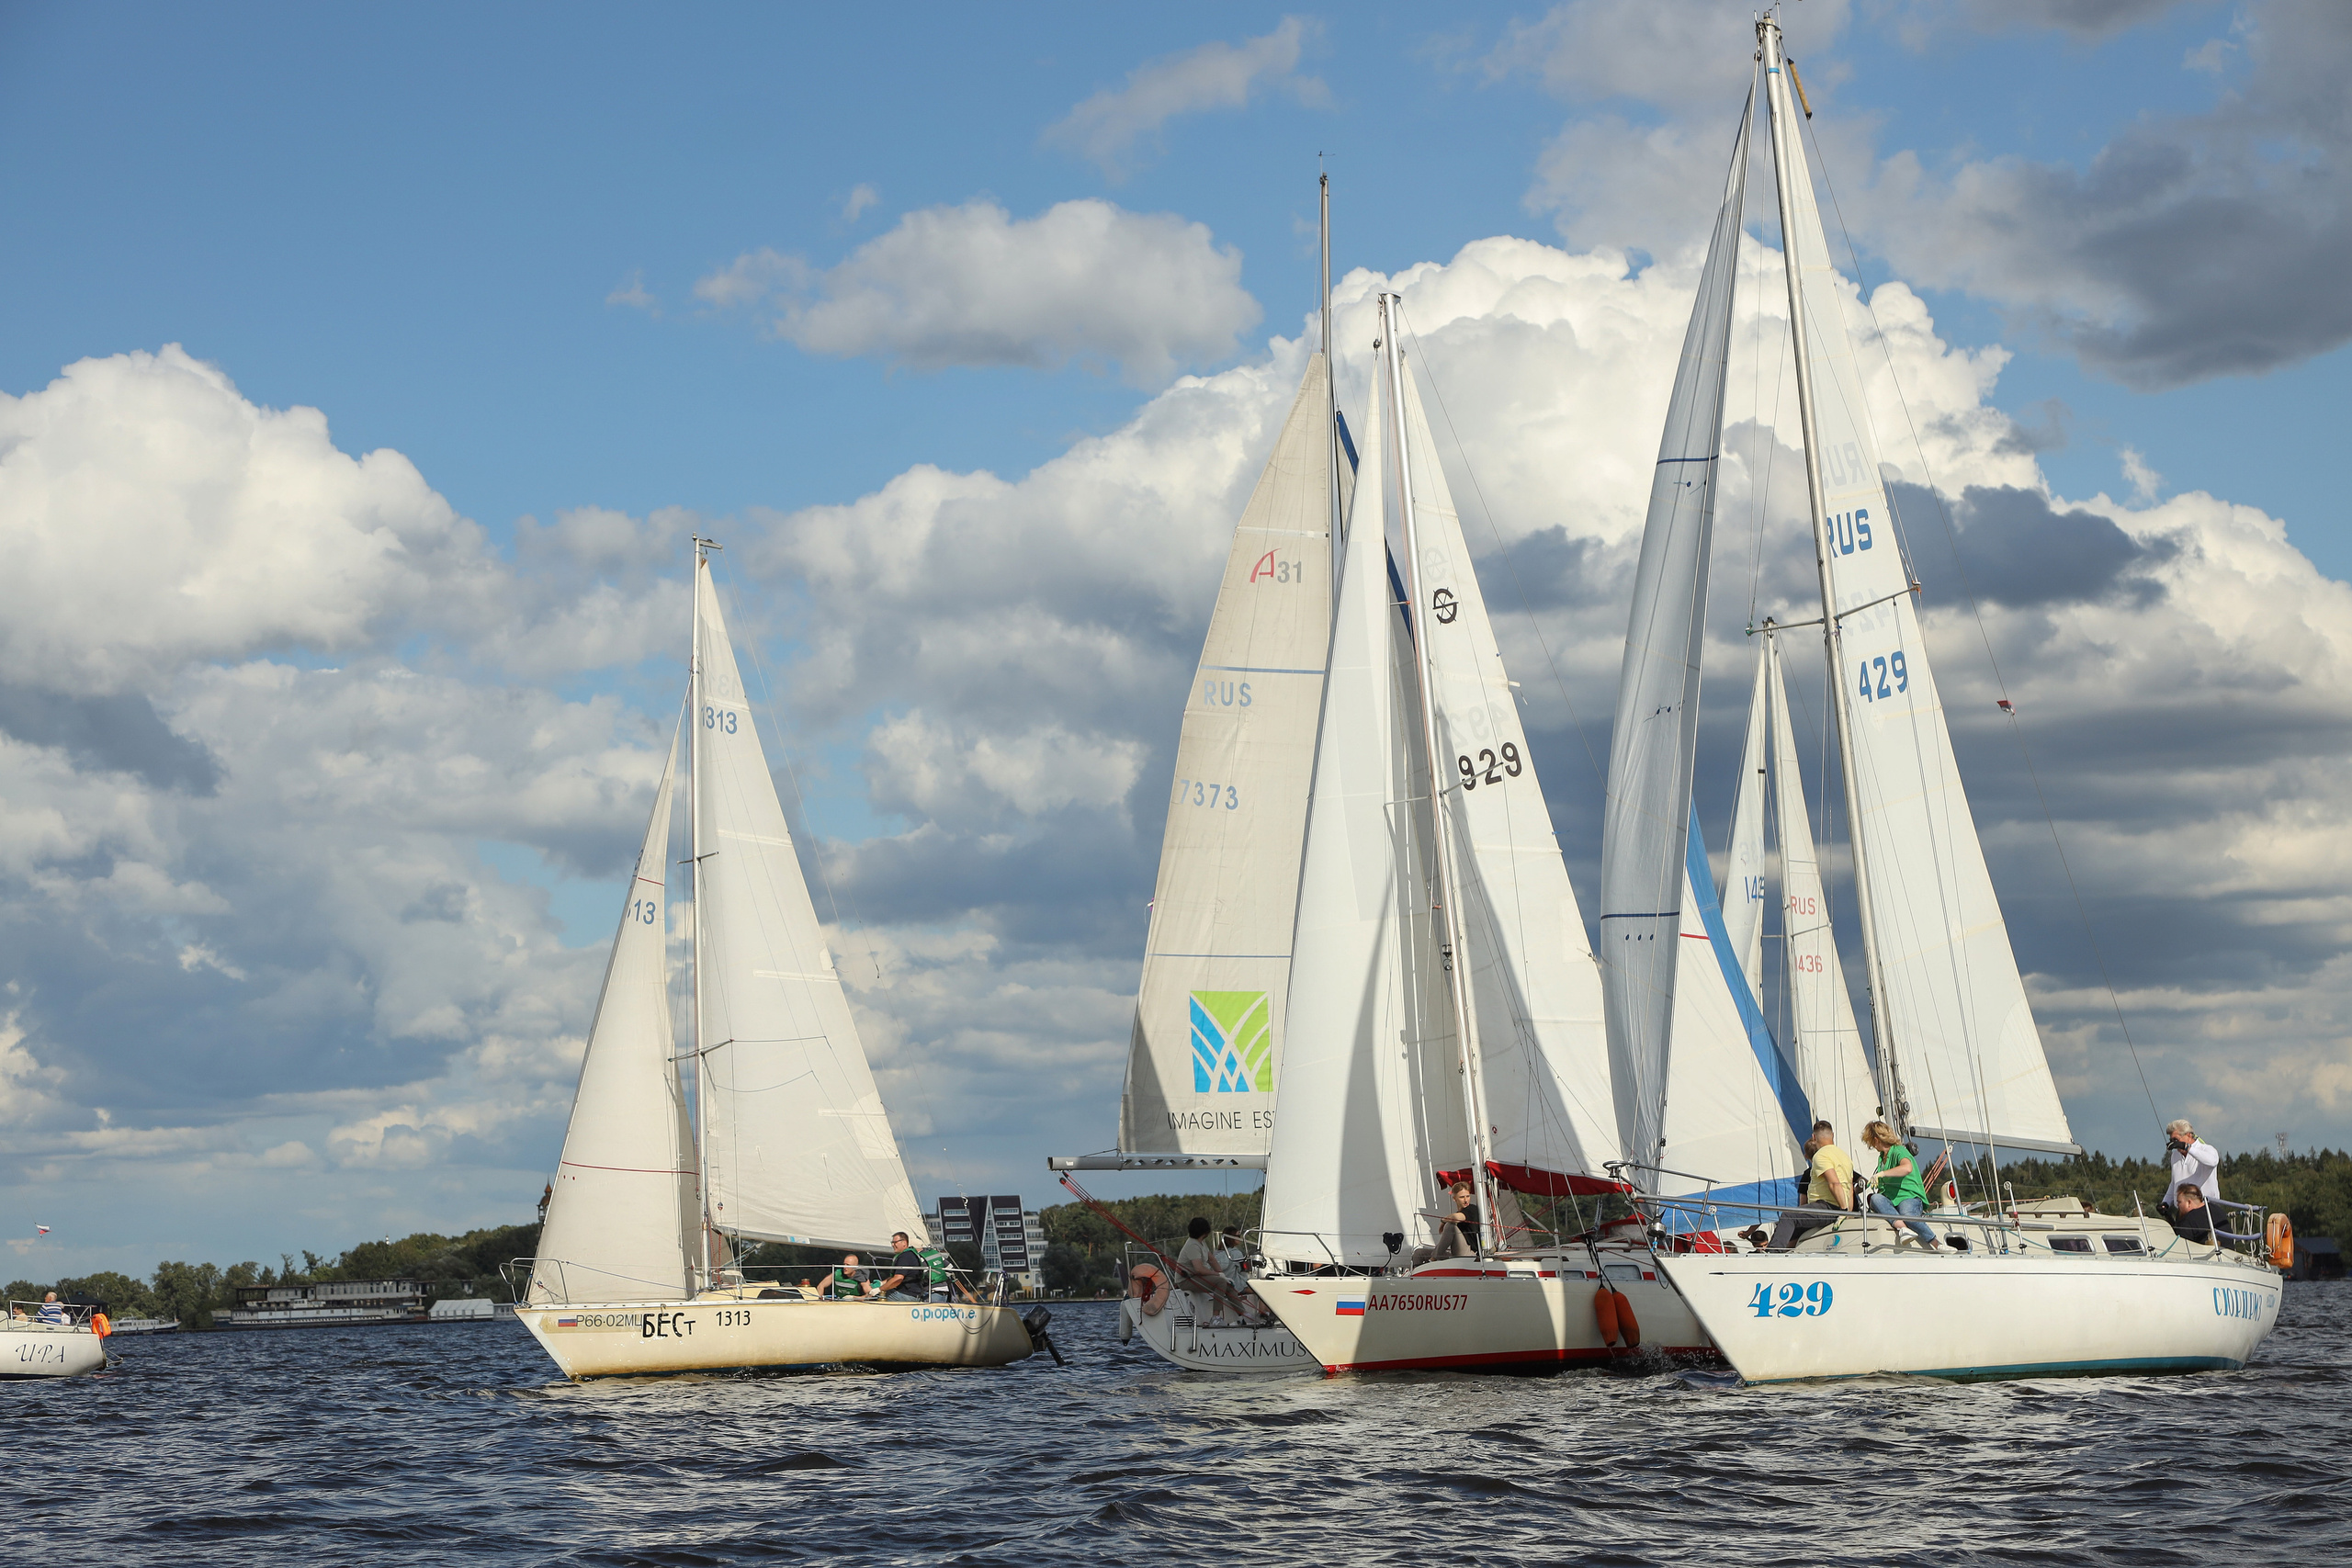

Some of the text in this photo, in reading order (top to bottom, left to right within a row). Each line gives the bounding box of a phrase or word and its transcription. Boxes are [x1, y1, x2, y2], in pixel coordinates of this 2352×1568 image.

[1859, 650, 1908, 703] 429
[1204, 681, 1252, 707] RUS
[1458, 742, 1522, 791] 929
[1180, 779, 1239, 810] 7373
[628, 898, 656, 925] 13
[1791, 896, 1816, 915] RUS
[1167, 1110, 1275, 1130] IMAGINE ES
[1367, 1294, 1468, 1311] AA7650RUS77
[1747, 1280, 1834, 1318] 429
[716, 1310, 752, 1326] 1313
[1198, 1341, 1307, 1359] MAXIMUS
